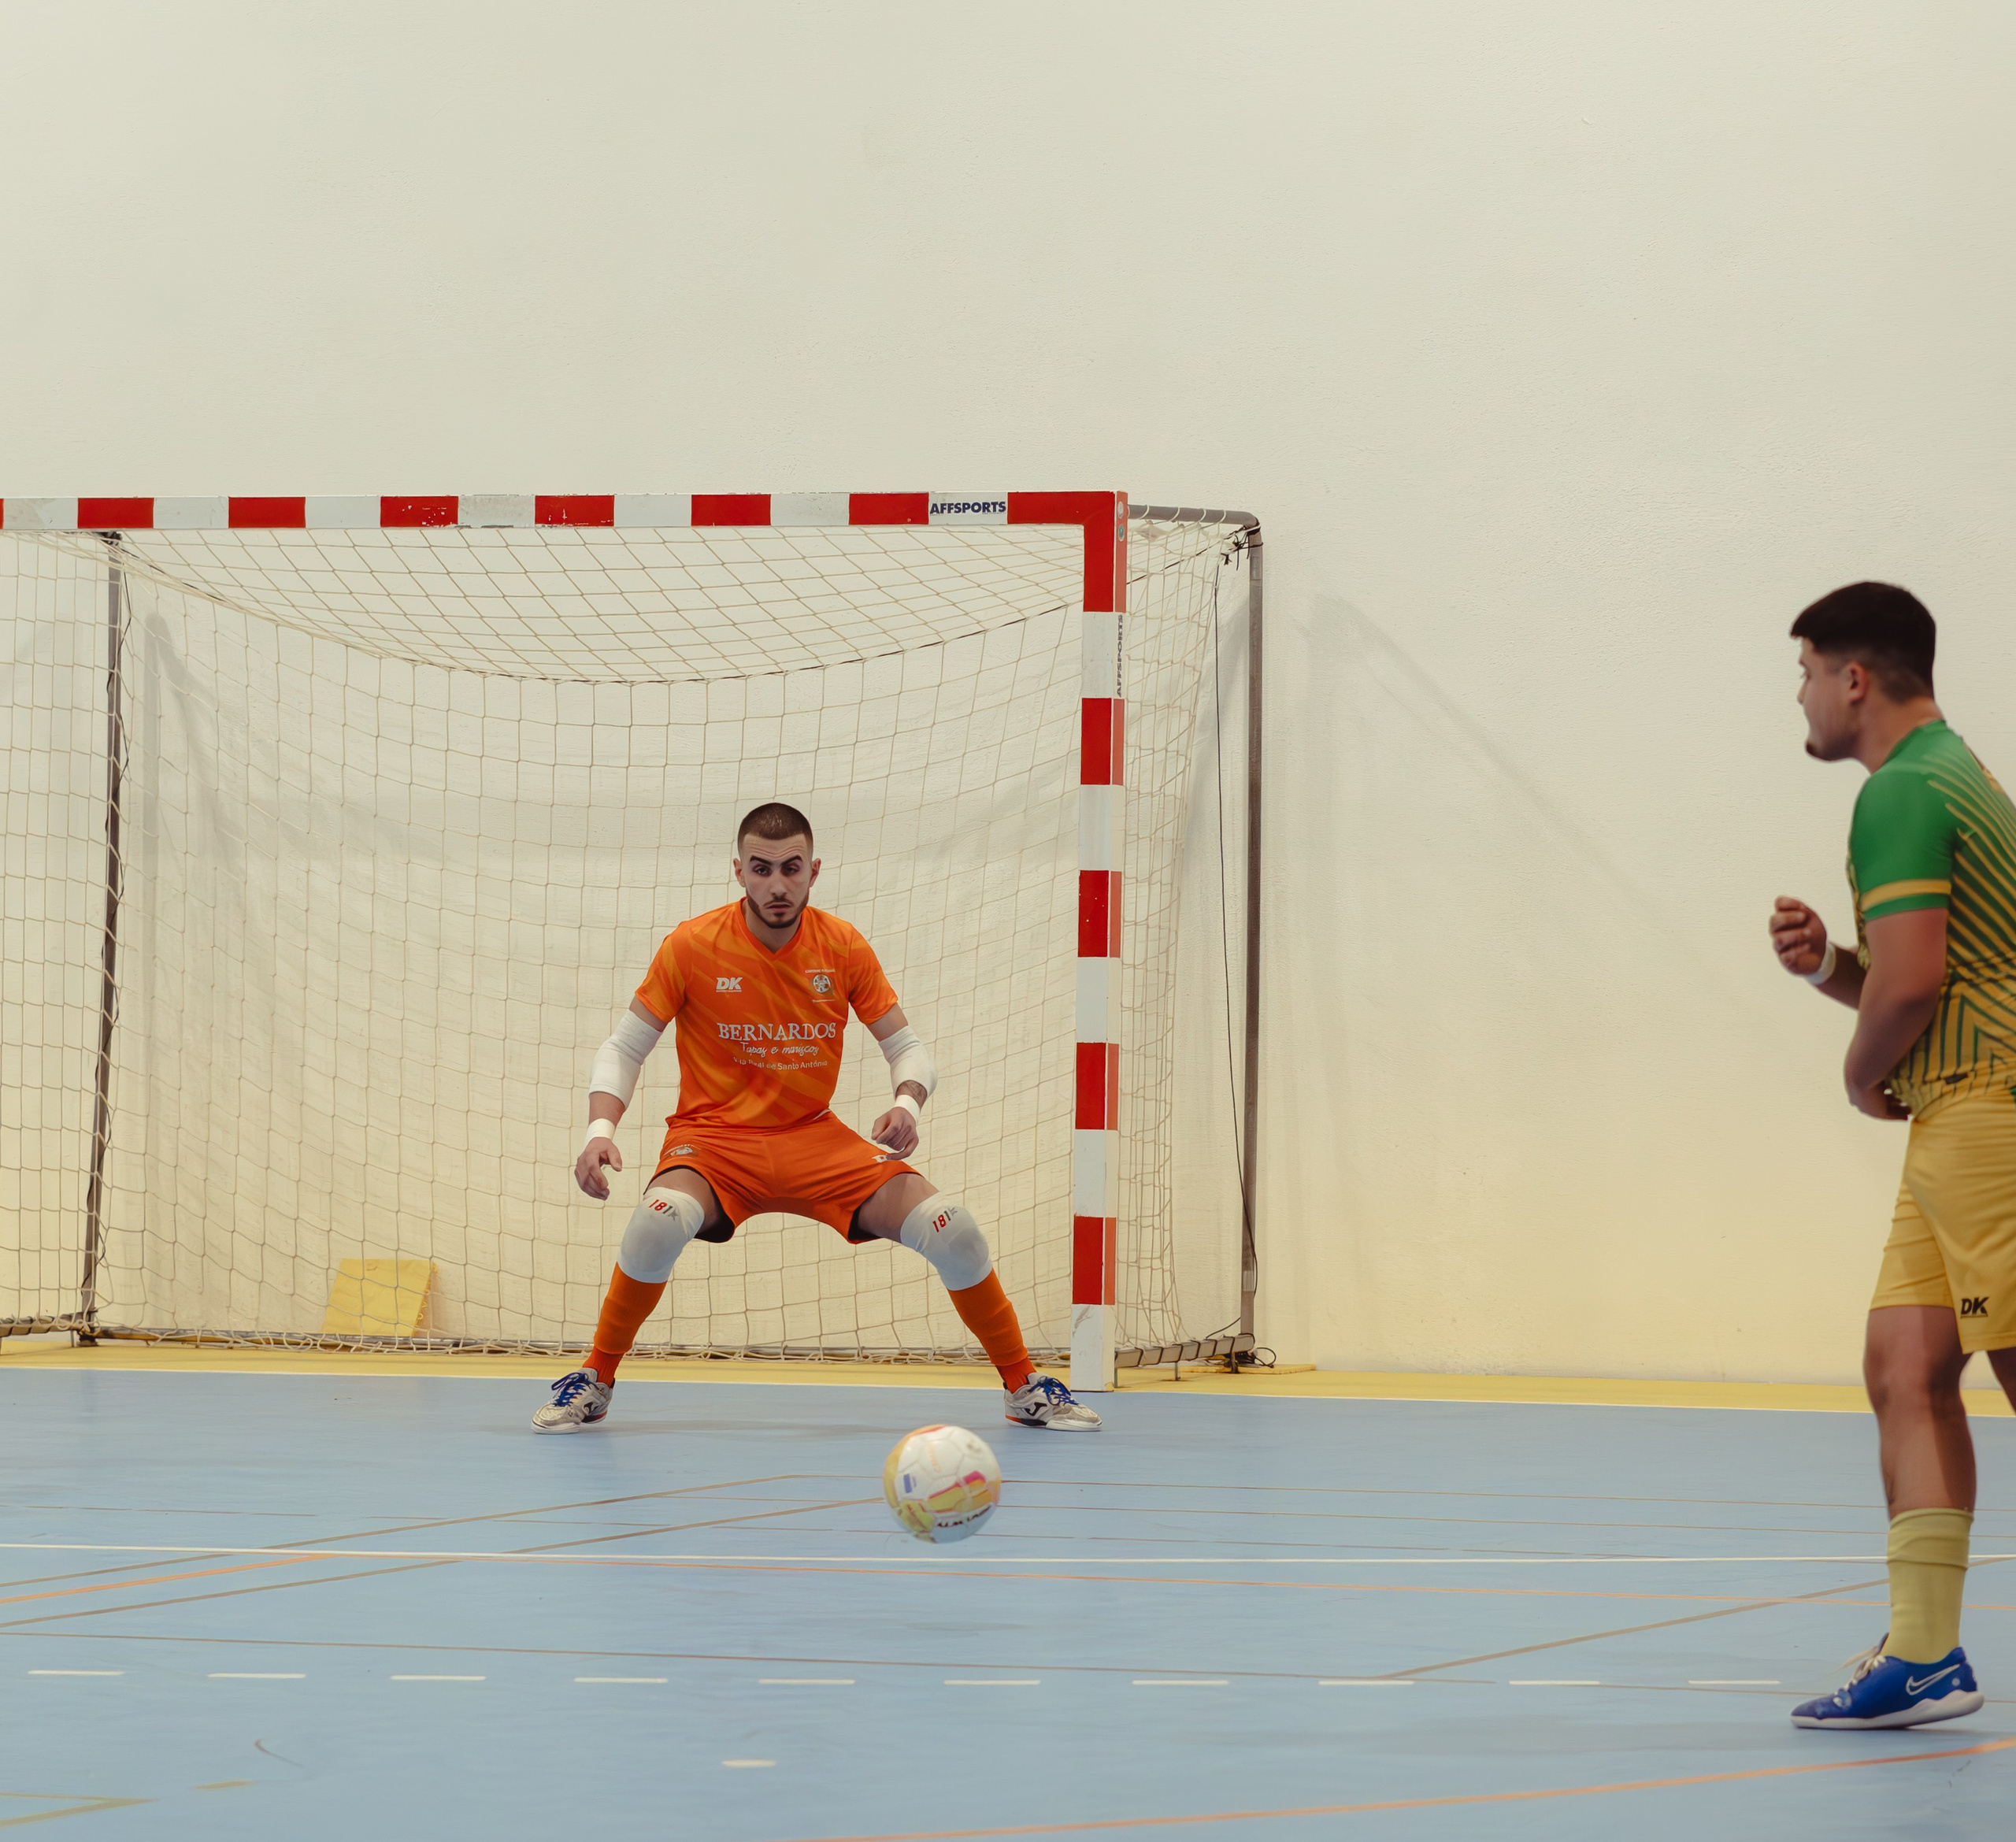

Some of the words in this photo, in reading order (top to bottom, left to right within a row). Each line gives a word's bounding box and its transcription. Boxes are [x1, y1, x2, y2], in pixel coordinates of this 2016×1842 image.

[929, 501, 1006, 514] AFFSPORTS
[716, 977, 743, 990] DK
[717, 1022, 836, 1041] BERNARDOS
[932, 1210, 951, 1232] 181
[1961, 1296, 1989, 1315] DK
